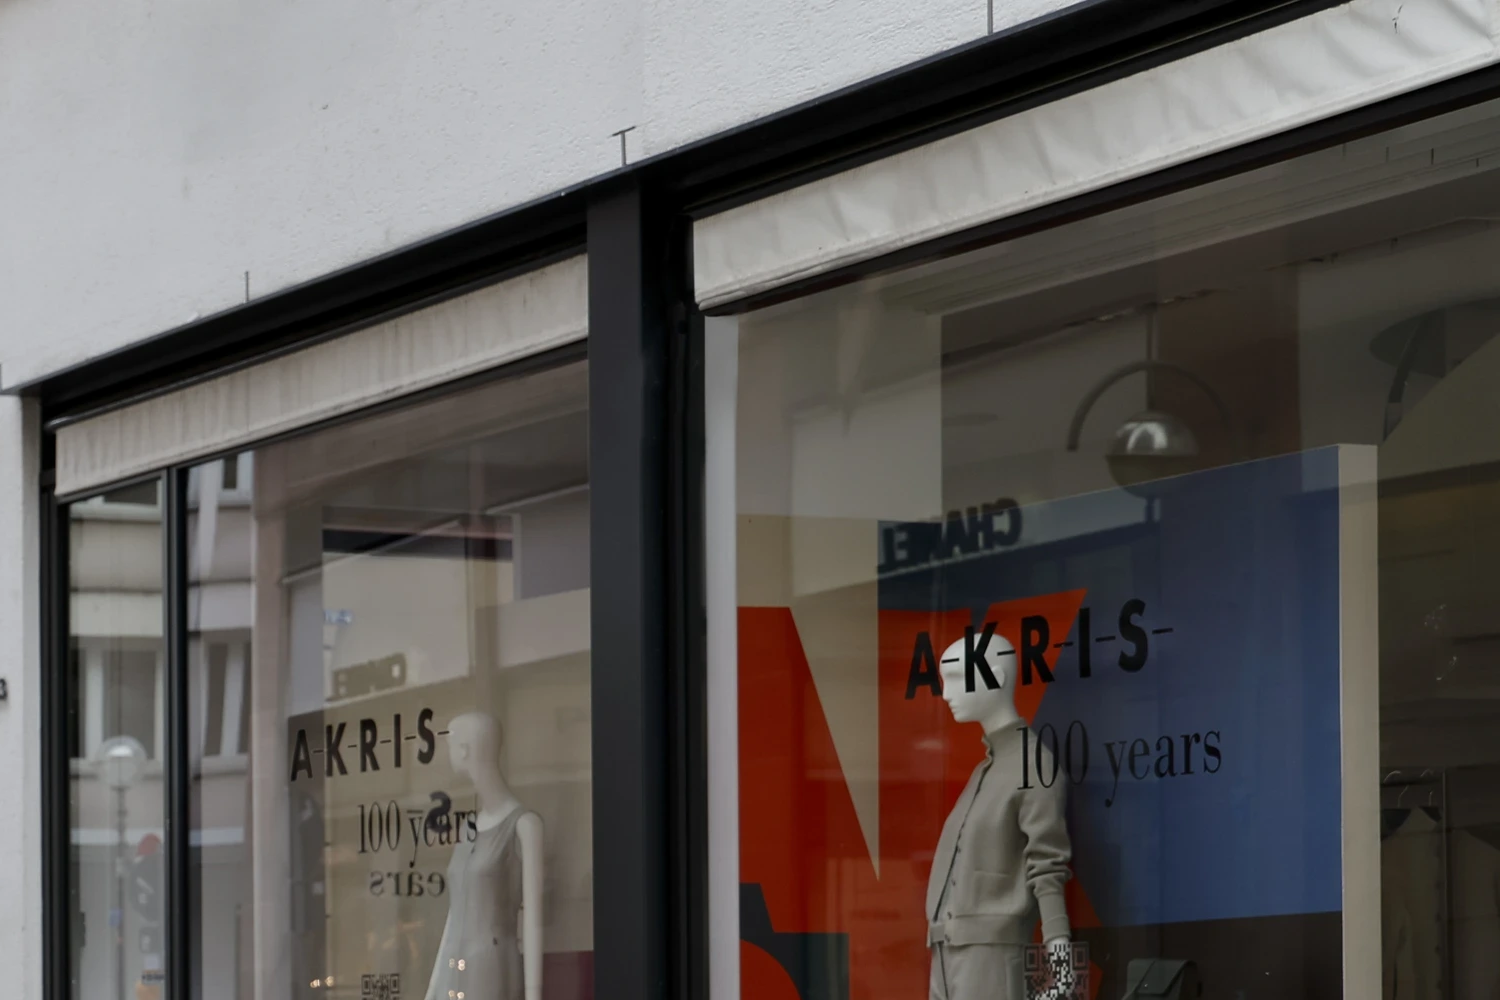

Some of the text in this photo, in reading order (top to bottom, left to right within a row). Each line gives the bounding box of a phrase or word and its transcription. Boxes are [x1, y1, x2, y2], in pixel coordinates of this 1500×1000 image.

[1016, 720, 1222, 807] 100 years
[358, 801, 400, 854] 100
[408, 810, 477, 868] years
